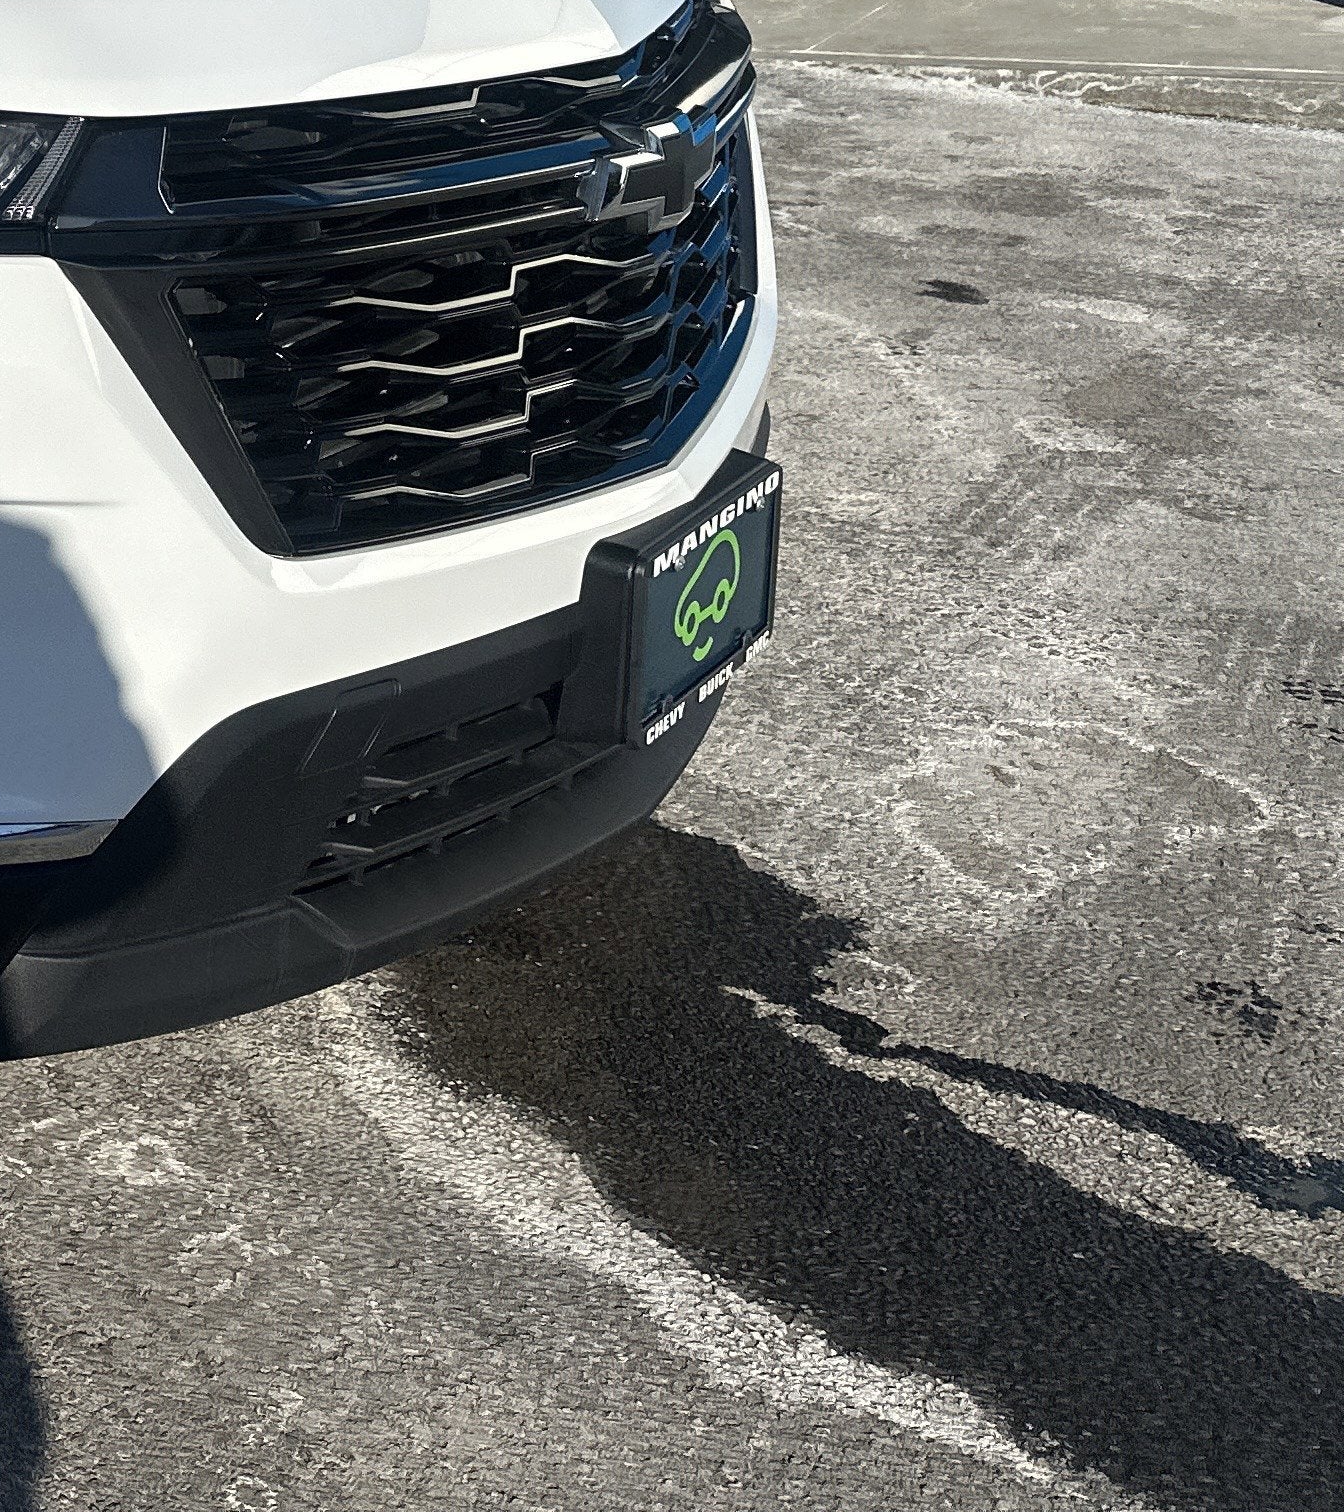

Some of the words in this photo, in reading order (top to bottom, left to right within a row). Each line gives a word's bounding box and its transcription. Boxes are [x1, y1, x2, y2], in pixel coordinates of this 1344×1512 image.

[652, 470, 780, 578] MANGINO
[645, 700, 686, 746] CHEVY
[698, 661, 734, 704] BUICK
[745, 630, 771, 663] GMC
